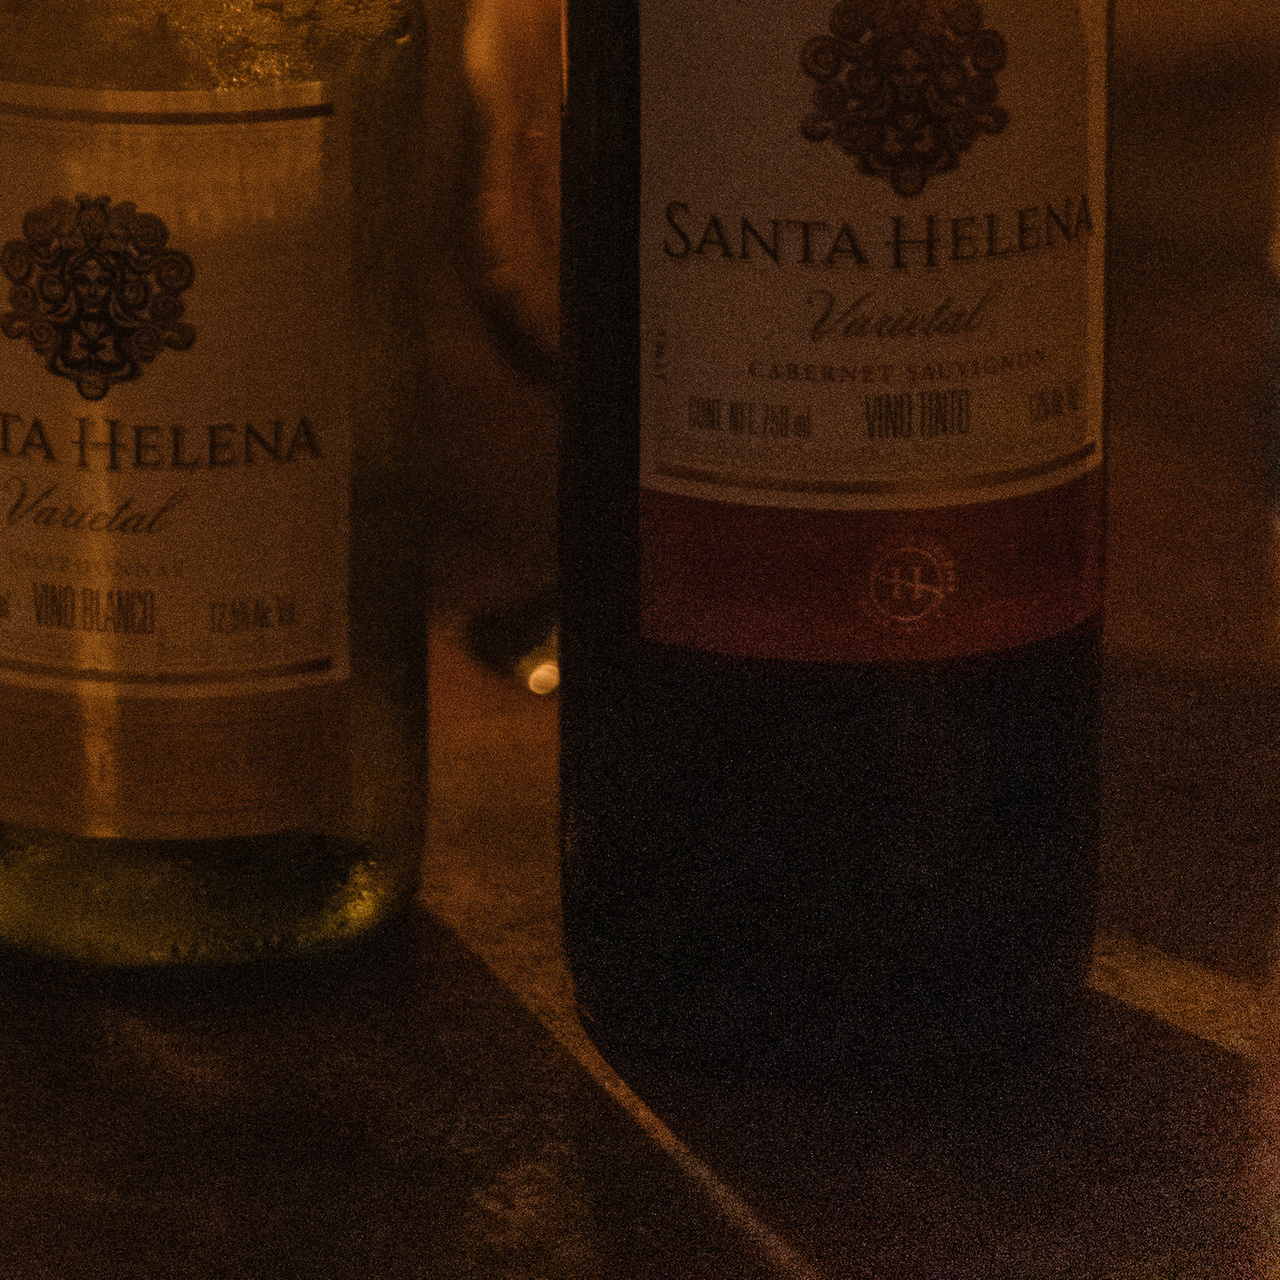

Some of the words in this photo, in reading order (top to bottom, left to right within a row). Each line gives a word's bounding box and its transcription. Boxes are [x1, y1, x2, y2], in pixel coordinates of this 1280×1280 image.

[663, 201, 869, 269] SANTA
[886, 193, 1094, 270] HELENA
[806, 279, 1005, 343] Varietal
[748, 358, 896, 384] CABERNET
[905, 348, 1047, 383] SAUVIGNON
[865, 391, 912, 439] VINO
[917, 388, 971, 438] TINTO
[72, 416, 324, 473] HELENA
[3, 475, 190, 535] Varietal
[32, 581, 76, 631] VINO
[81, 585, 155, 634] BLANCO
